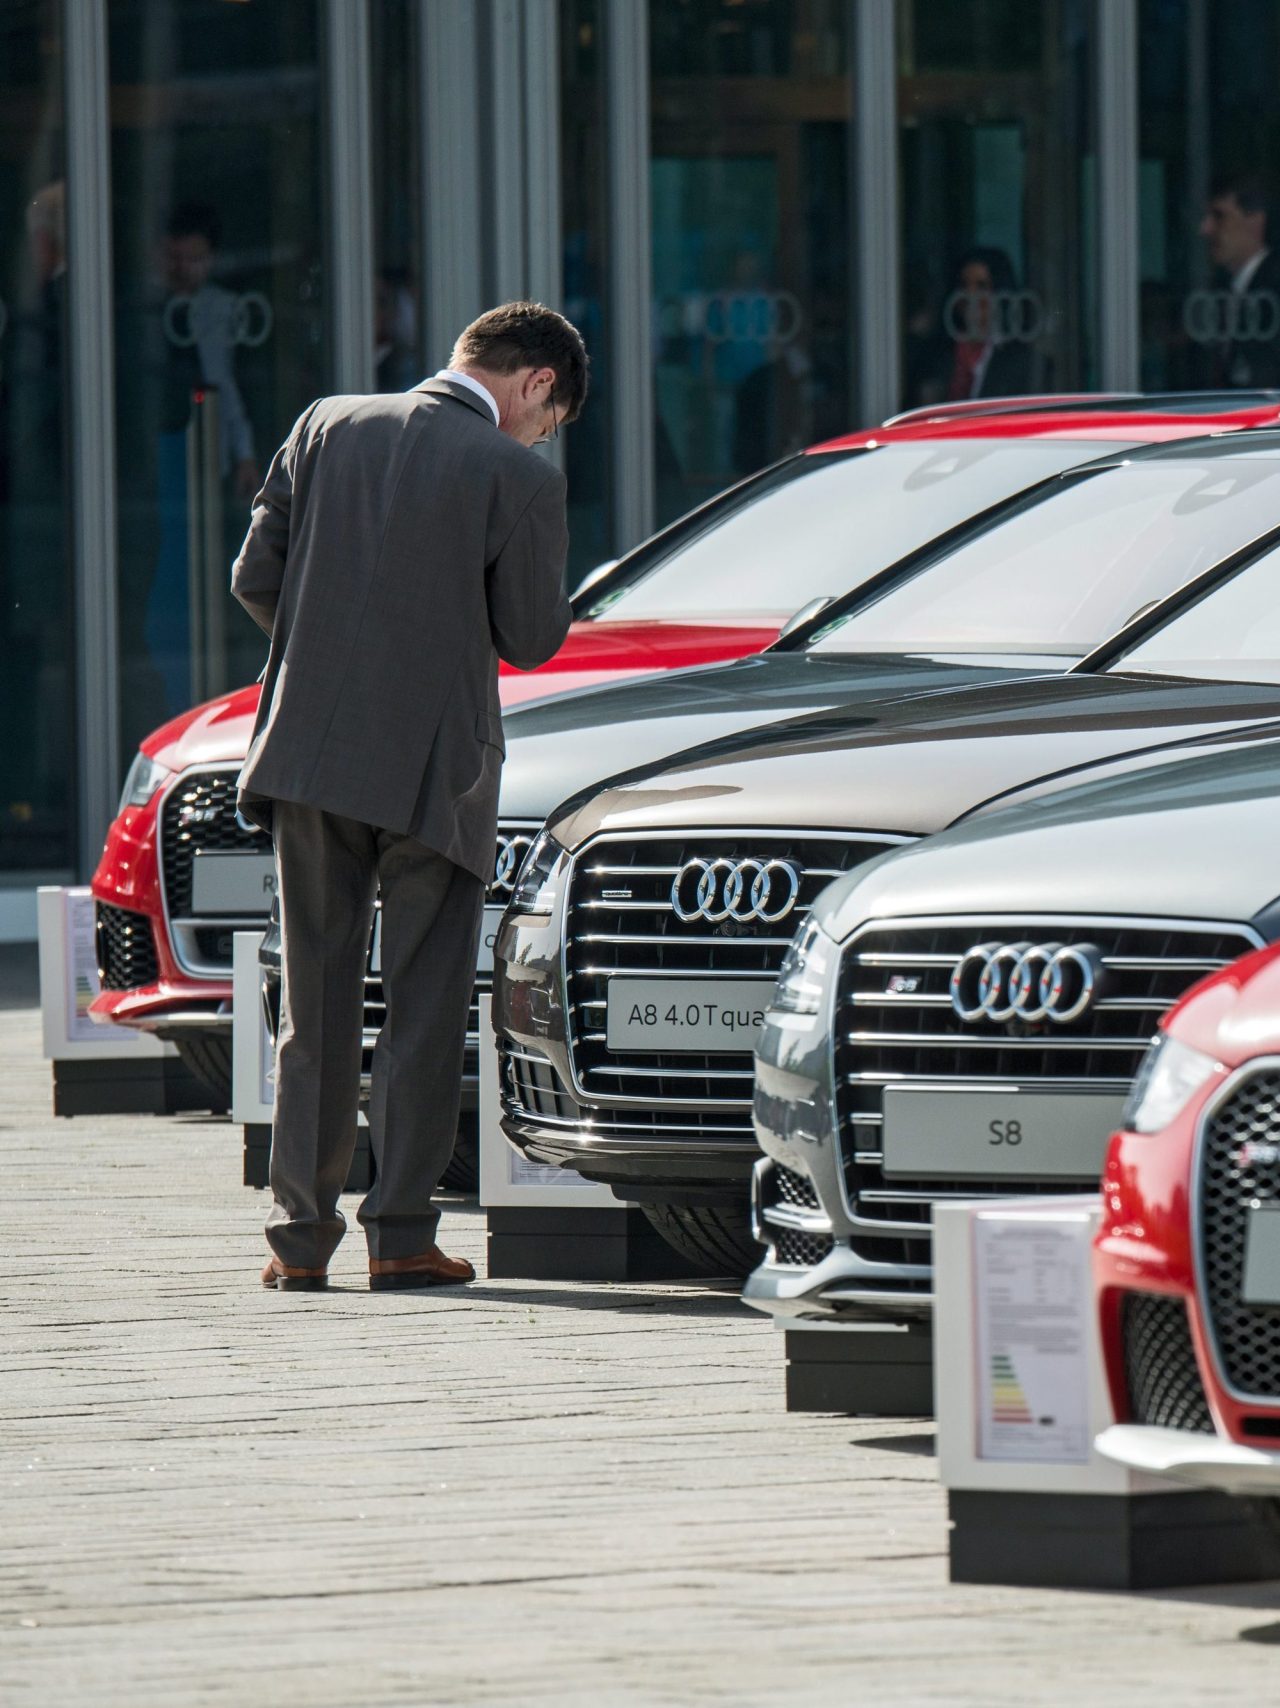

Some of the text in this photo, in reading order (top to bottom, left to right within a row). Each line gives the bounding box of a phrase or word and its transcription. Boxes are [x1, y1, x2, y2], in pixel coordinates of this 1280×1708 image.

[263, 873, 279, 894] R
[628, 1004, 658, 1026] A8
[989, 1120, 1022, 1146] S8
